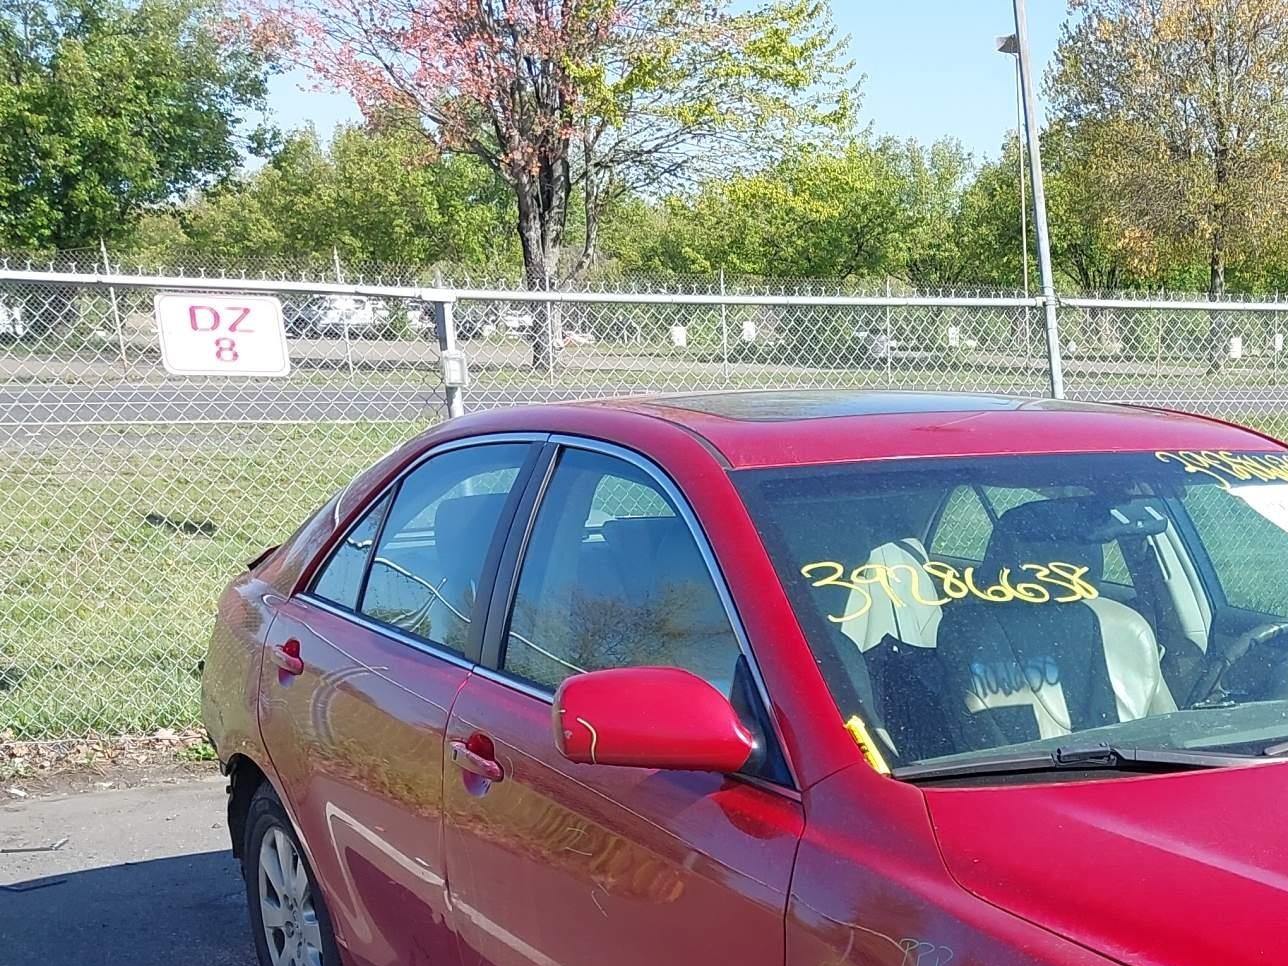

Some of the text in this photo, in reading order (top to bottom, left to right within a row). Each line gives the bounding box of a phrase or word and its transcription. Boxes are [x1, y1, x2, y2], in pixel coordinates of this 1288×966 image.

[188, 305, 255, 332] DZ
[215, 337, 239, 362] 8
[800, 561, 1099, 623] 39286638
